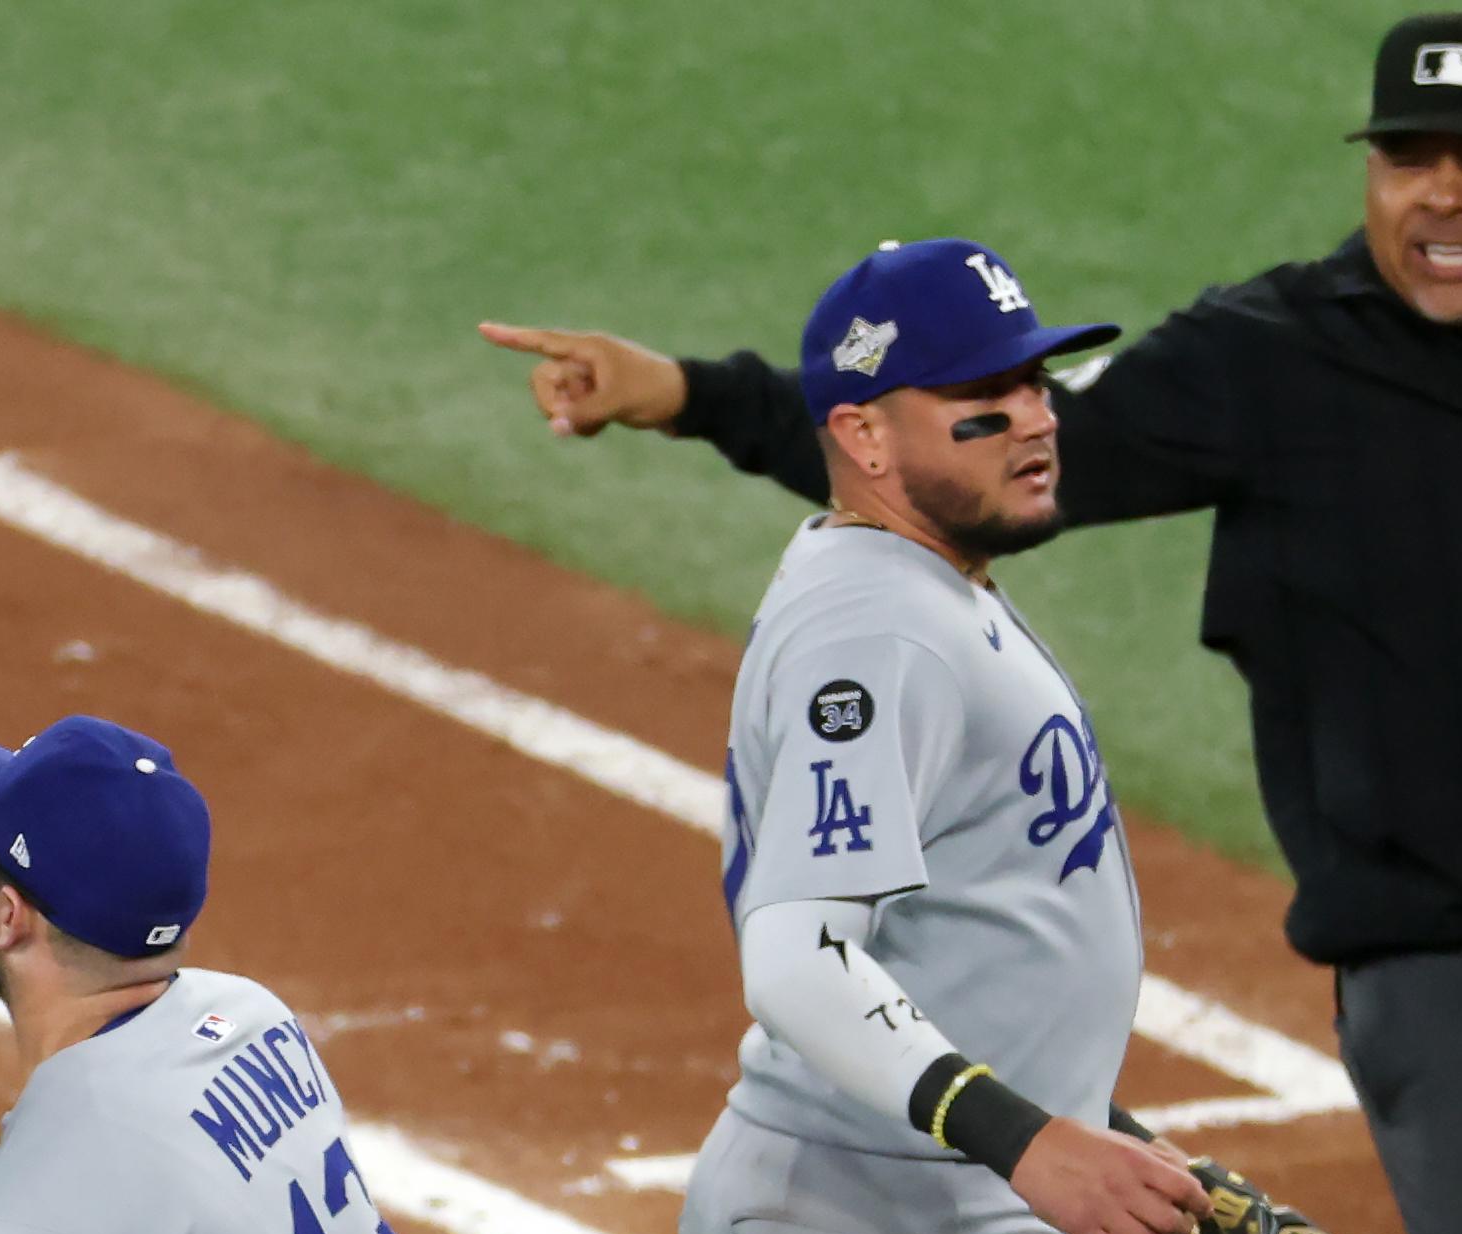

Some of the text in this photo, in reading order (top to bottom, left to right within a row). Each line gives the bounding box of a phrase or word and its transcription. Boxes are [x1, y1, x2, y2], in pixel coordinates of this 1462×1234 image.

[964, 252, 1029, 313] LA
[820, 702, 863, 733] 34
[809, 760, 872, 857] LA
[190, 1018, 327, 1182] MUNCY
